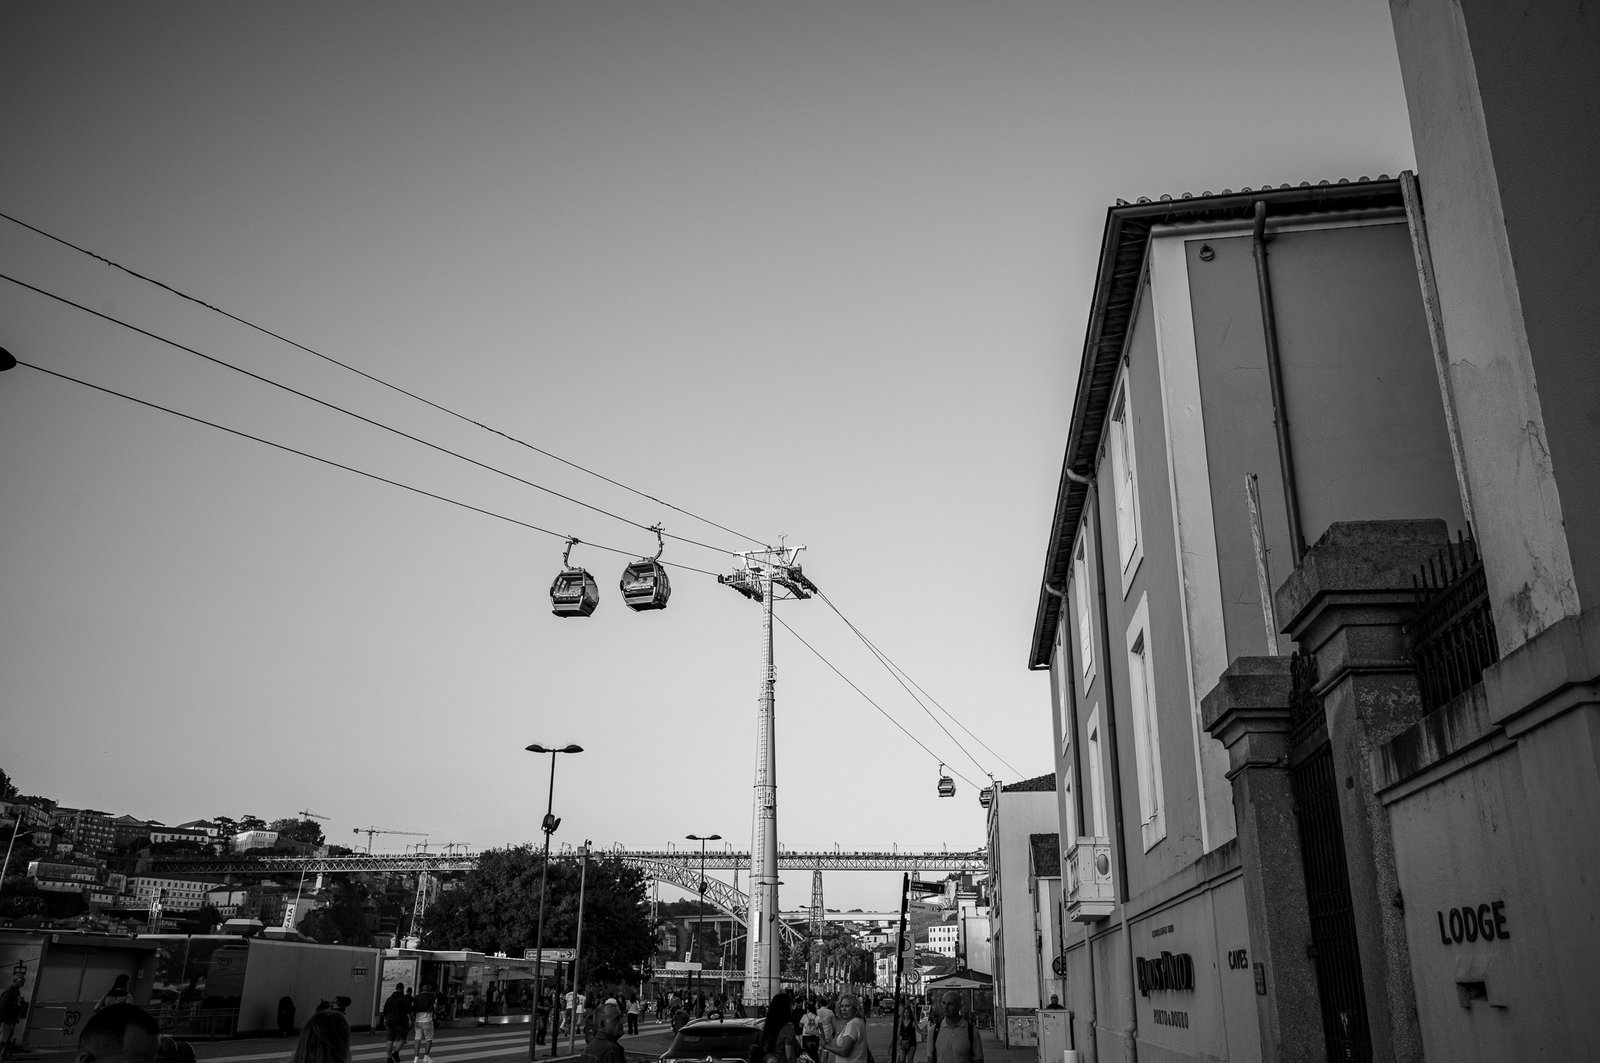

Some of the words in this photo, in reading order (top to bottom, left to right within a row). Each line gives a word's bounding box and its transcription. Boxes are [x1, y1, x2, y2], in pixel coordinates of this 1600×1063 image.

[1437, 900, 1510, 945] LODGE
[1228, 949, 1249, 970] CAVES
[908, 973, 918, 981] 20
